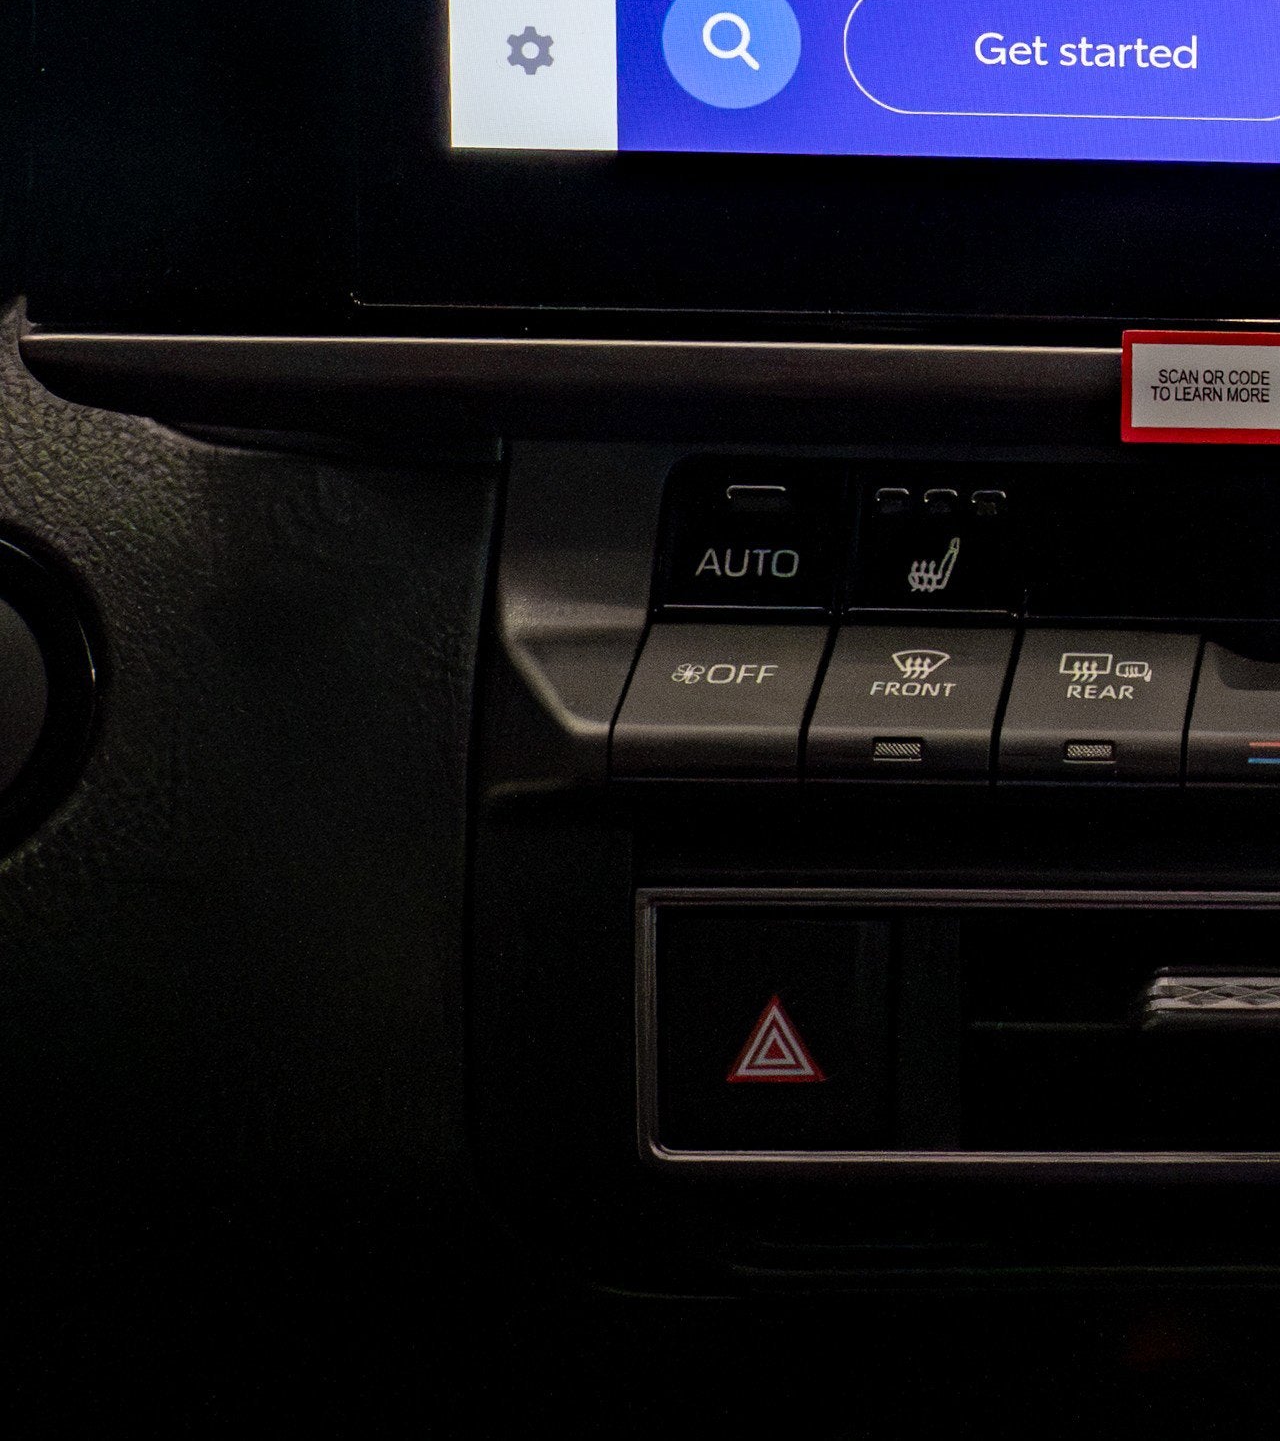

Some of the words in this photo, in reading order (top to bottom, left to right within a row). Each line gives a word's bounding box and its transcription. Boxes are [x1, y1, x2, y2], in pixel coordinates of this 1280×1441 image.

[974, 32, 1049, 66] Get
[1059, 34, 1198, 69] started
[1158, 368, 1199, 385] SCAN
[1202, 369, 1225, 385] QR
[1228, 369, 1271, 386] CODE
[1150, 385, 1172, 402] TO
[1174, 386, 1223, 402] LEARN
[1226, 387, 1270, 403] MORE
[695, 548, 800, 578] AUTO
[706, 663, 779, 684] OFF
[869, 681, 957, 697] FRONT
[1066, 684, 1134, 700] REAR
